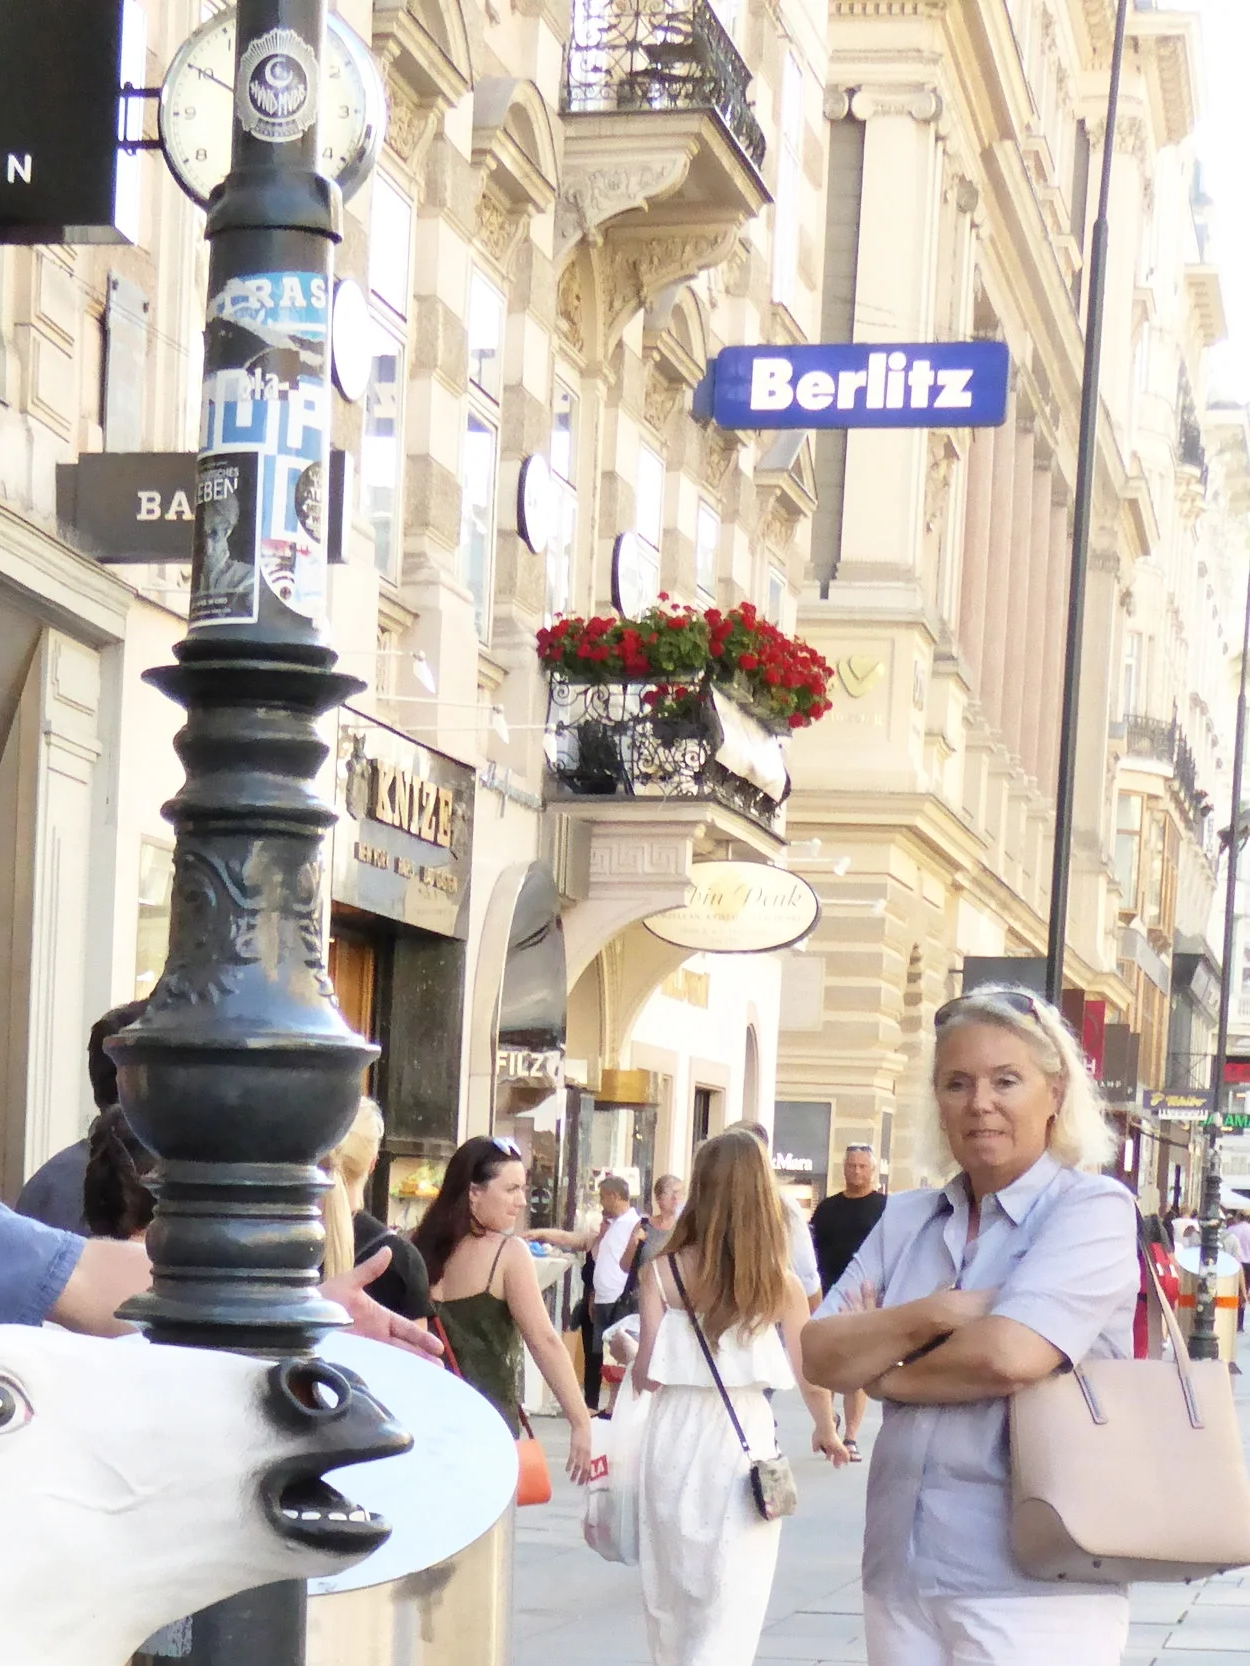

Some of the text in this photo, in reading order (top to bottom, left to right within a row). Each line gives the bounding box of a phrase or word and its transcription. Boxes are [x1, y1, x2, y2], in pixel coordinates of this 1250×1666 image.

[184, 106, 197, 120] 9
[195, 147, 208, 161] 8
[750, 351, 974, 411] Berlitz
[375, 756, 454, 849] KNIZE
